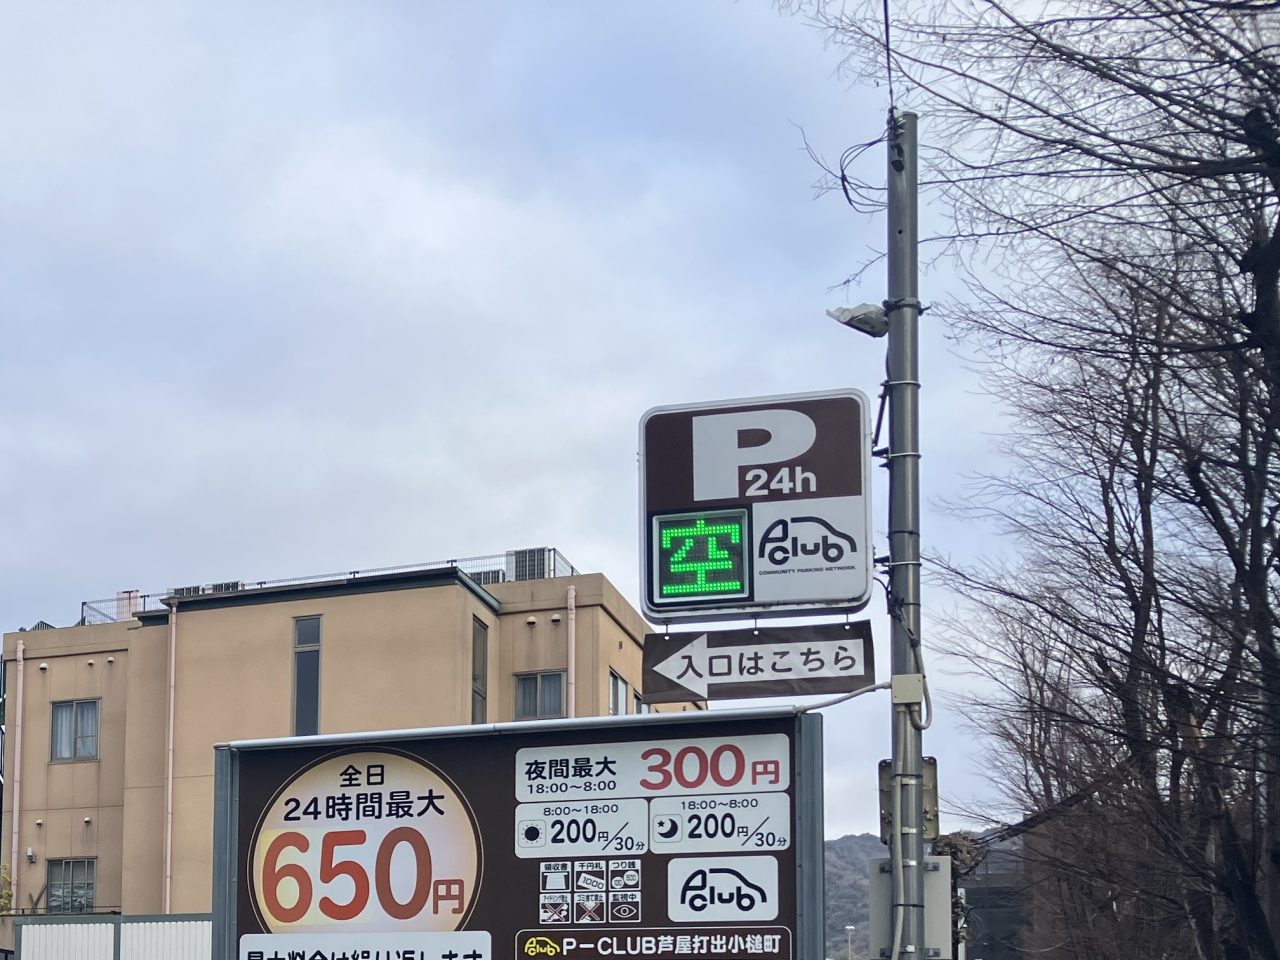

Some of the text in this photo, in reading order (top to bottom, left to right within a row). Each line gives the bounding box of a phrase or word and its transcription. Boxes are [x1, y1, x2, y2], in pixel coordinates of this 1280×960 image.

[692, 408, 817, 502] P
[745, 466, 817, 497] 24h
[662, 518, 741, 595] 空
[677, 646, 856, 680] 入口はこちら
[339, 764, 386, 788] 全日
[525, 756, 617, 781] 夜間最大
[283, 788, 445, 822] 24時間最大
[262, 826, 465, 923] 650円
[578, 861, 603, 870] 千円札
[583, 876, 605, 890] 1000
